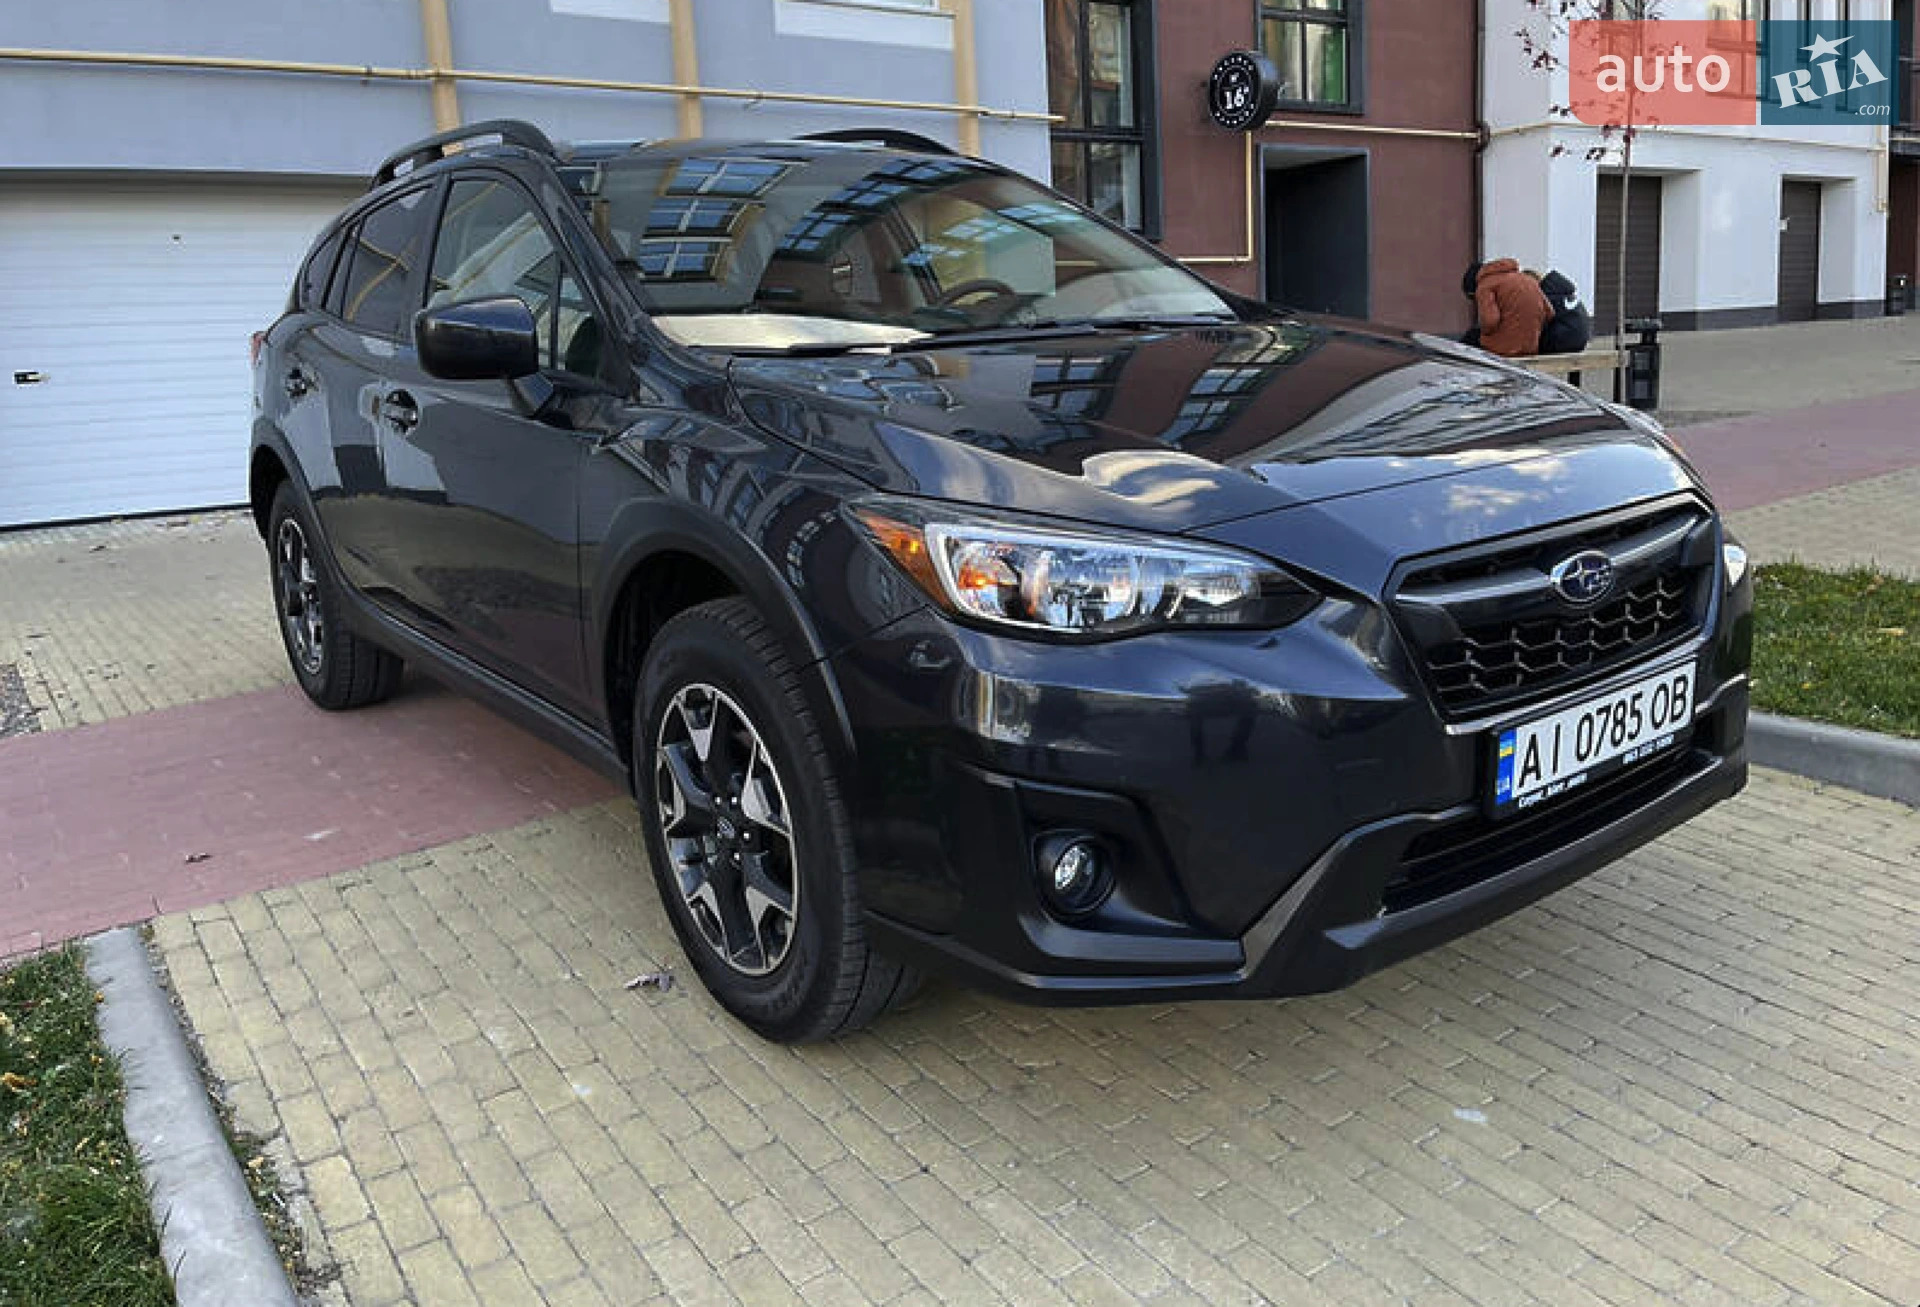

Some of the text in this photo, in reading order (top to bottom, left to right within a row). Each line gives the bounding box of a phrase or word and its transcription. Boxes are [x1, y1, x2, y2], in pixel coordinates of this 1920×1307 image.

[1518, 722, 1562, 789] AI
[1575, 691, 1643, 762] 0785
[1651, 673, 1689, 730] OB
